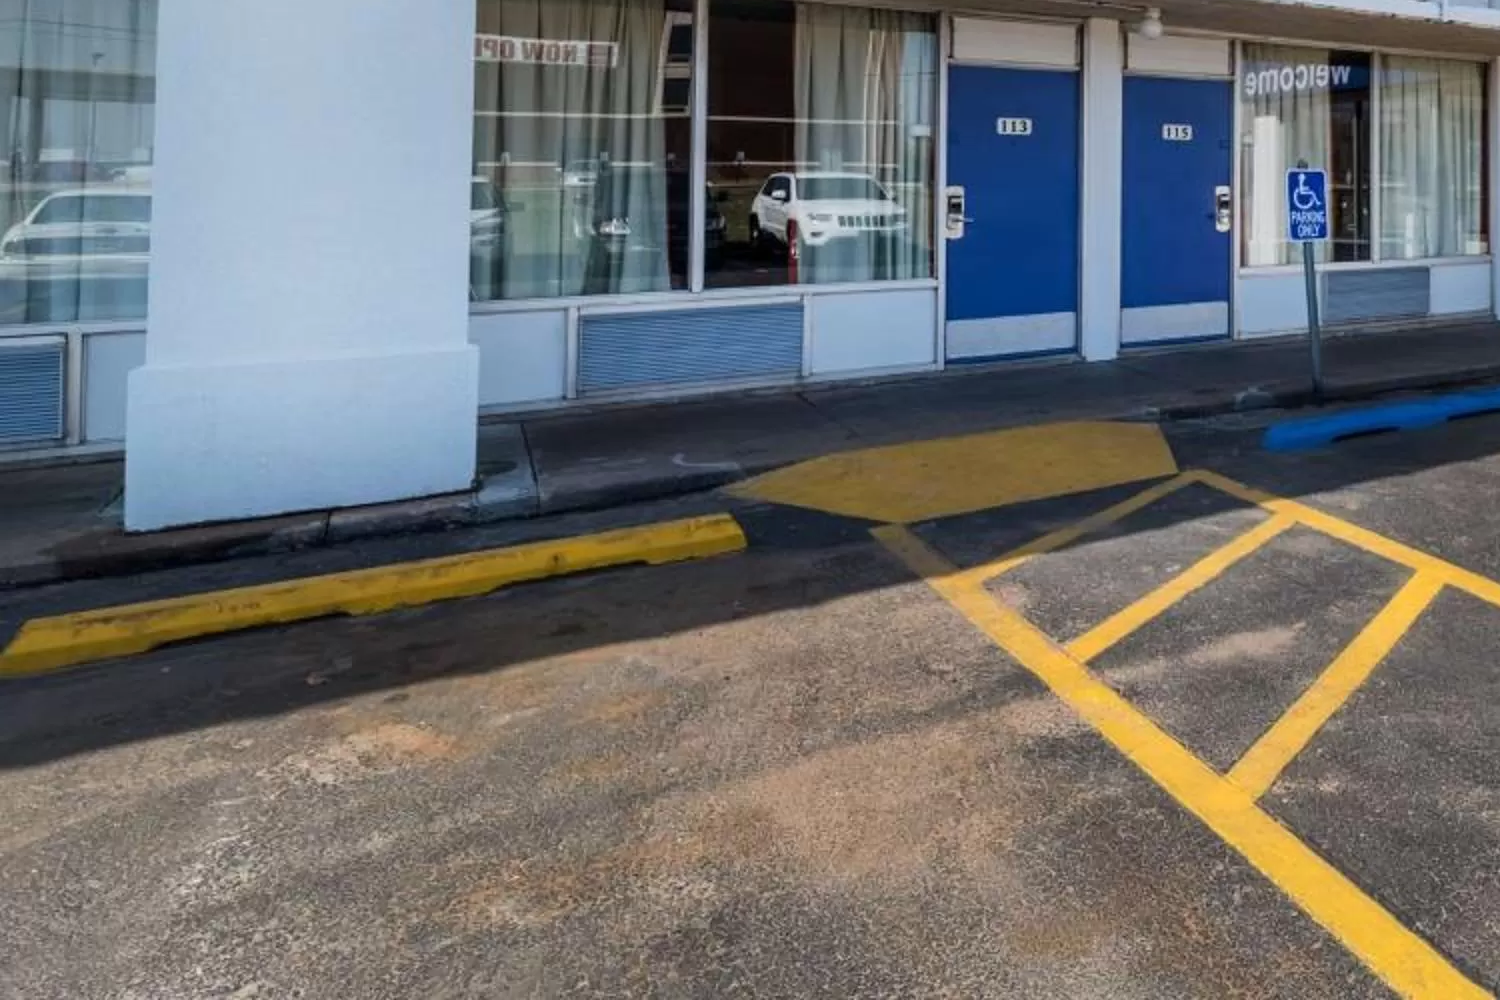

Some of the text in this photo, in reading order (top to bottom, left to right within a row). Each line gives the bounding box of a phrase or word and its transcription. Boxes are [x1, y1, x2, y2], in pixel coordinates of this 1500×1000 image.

[1001, 119, 1028, 133] 113
[1166, 126, 1189, 139] 115
[1291, 211, 1325, 225] PARKING
[1297, 223, 1321, 237] ONLY
